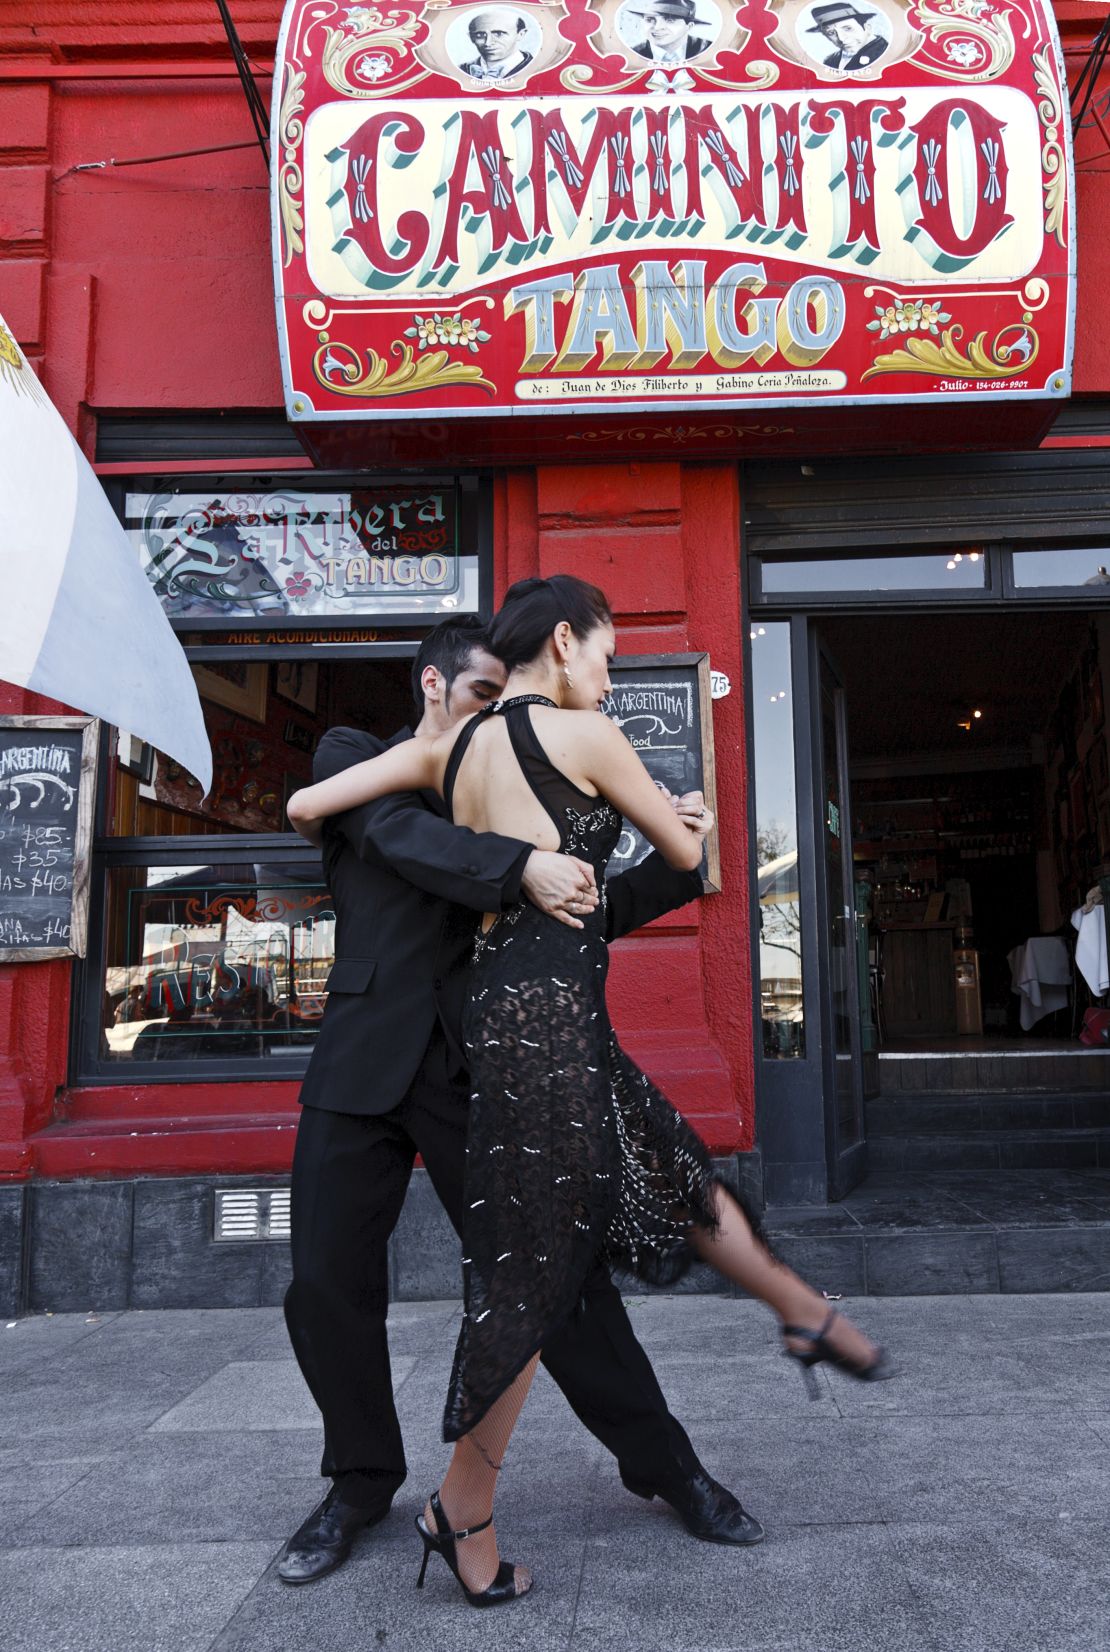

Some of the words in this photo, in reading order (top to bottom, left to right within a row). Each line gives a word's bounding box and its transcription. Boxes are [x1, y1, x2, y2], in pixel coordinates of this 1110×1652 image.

[324, 95, 1016, 291] CAMINITO
[503, 260, 847, 374] TANGO
[561, 380, 592, 394] Juan
[595, 380, 606, 392] de
[611, 378, 637, 392] Dios
[641, 377, 689, 391] Filiberto
[695, 380, 703, 393] y
[715, 375, 754, 392] Gabino
[168, 503, 269, 600] La
[261, 490, 447, 567] Ribera
[321, 553, 448, 587] TANGO
[371, 534, 399, 551] del
